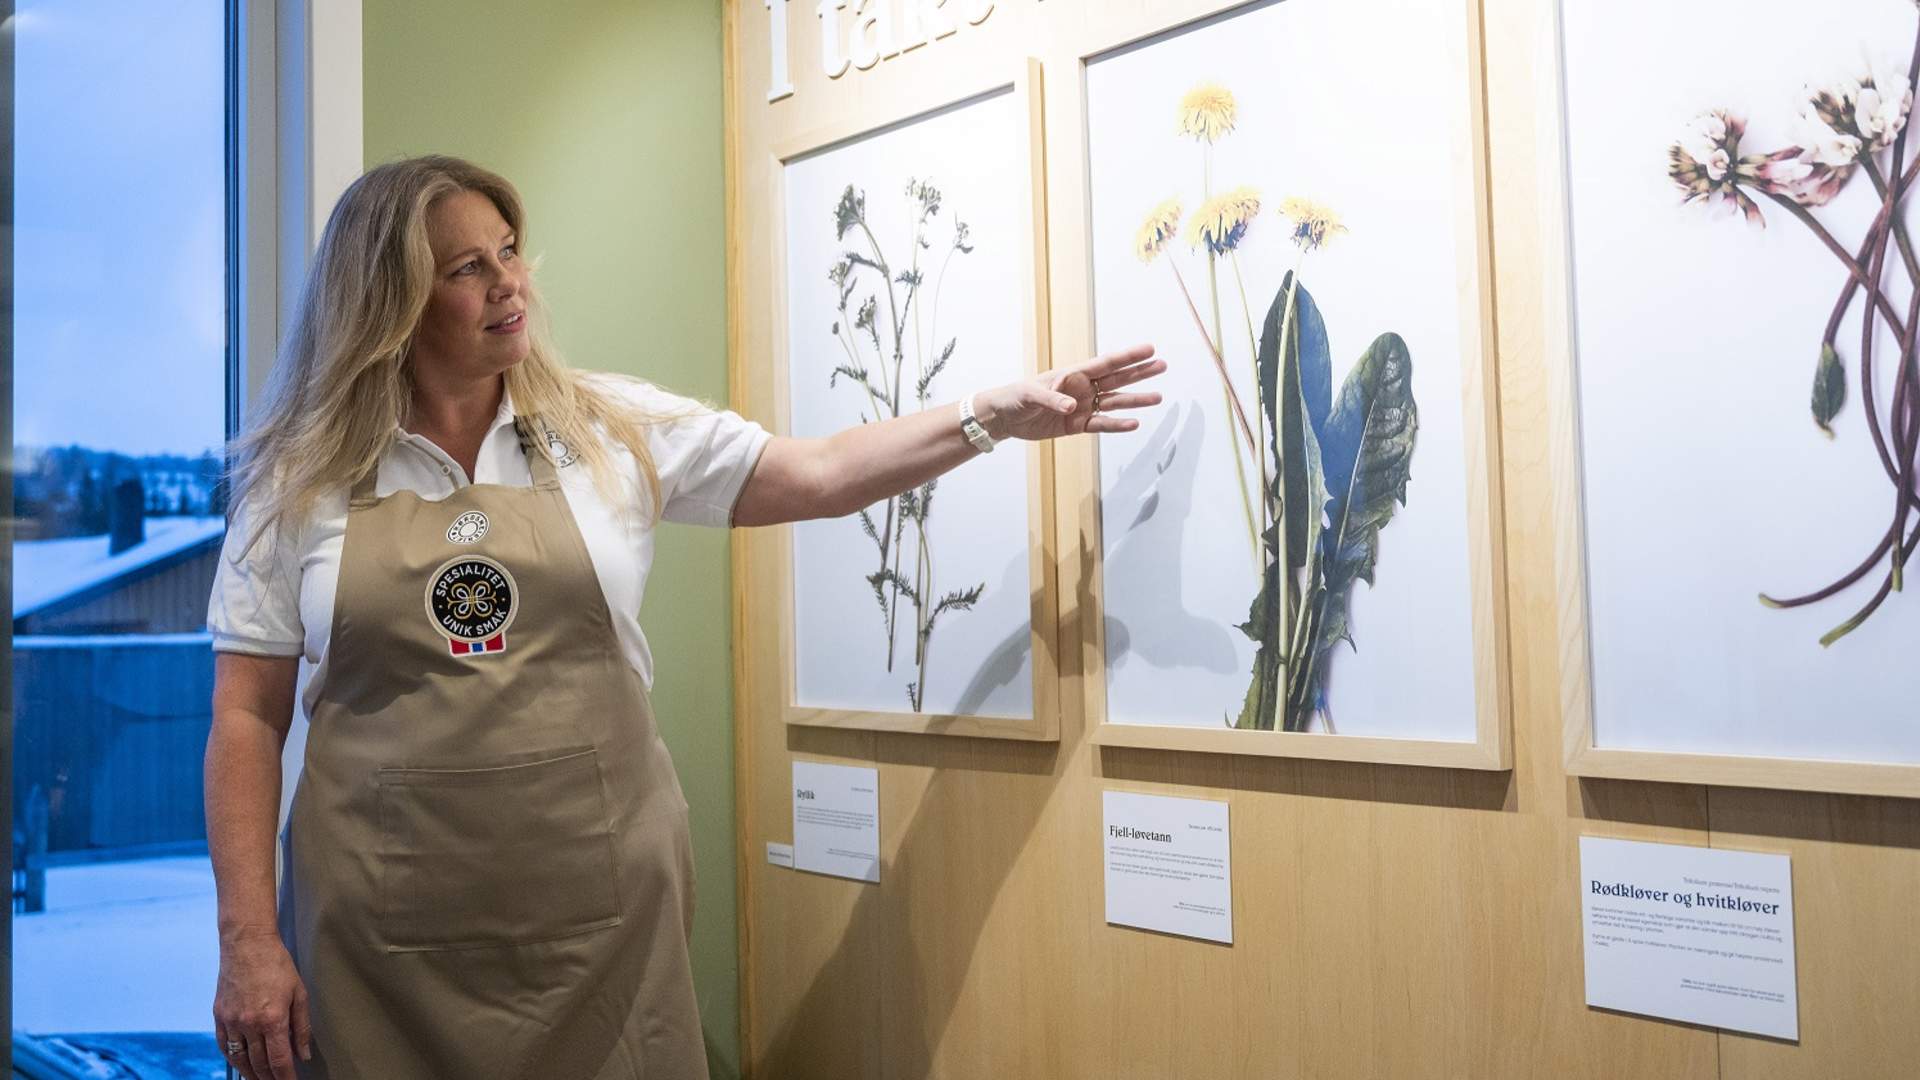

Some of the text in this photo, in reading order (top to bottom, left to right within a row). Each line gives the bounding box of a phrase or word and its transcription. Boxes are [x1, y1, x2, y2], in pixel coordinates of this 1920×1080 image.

[436, 564, 506, 597] SPESIALITET
[443, 609, 507, 636] UNIK SMAK
[1110, 824, 1172, 844] Fjell-løvetann
[1591, 880, 1669, 903] Rødkløver
[1672, 892, 1693, 909] og
[1696, 892, 1780, 916] hvitkløver
